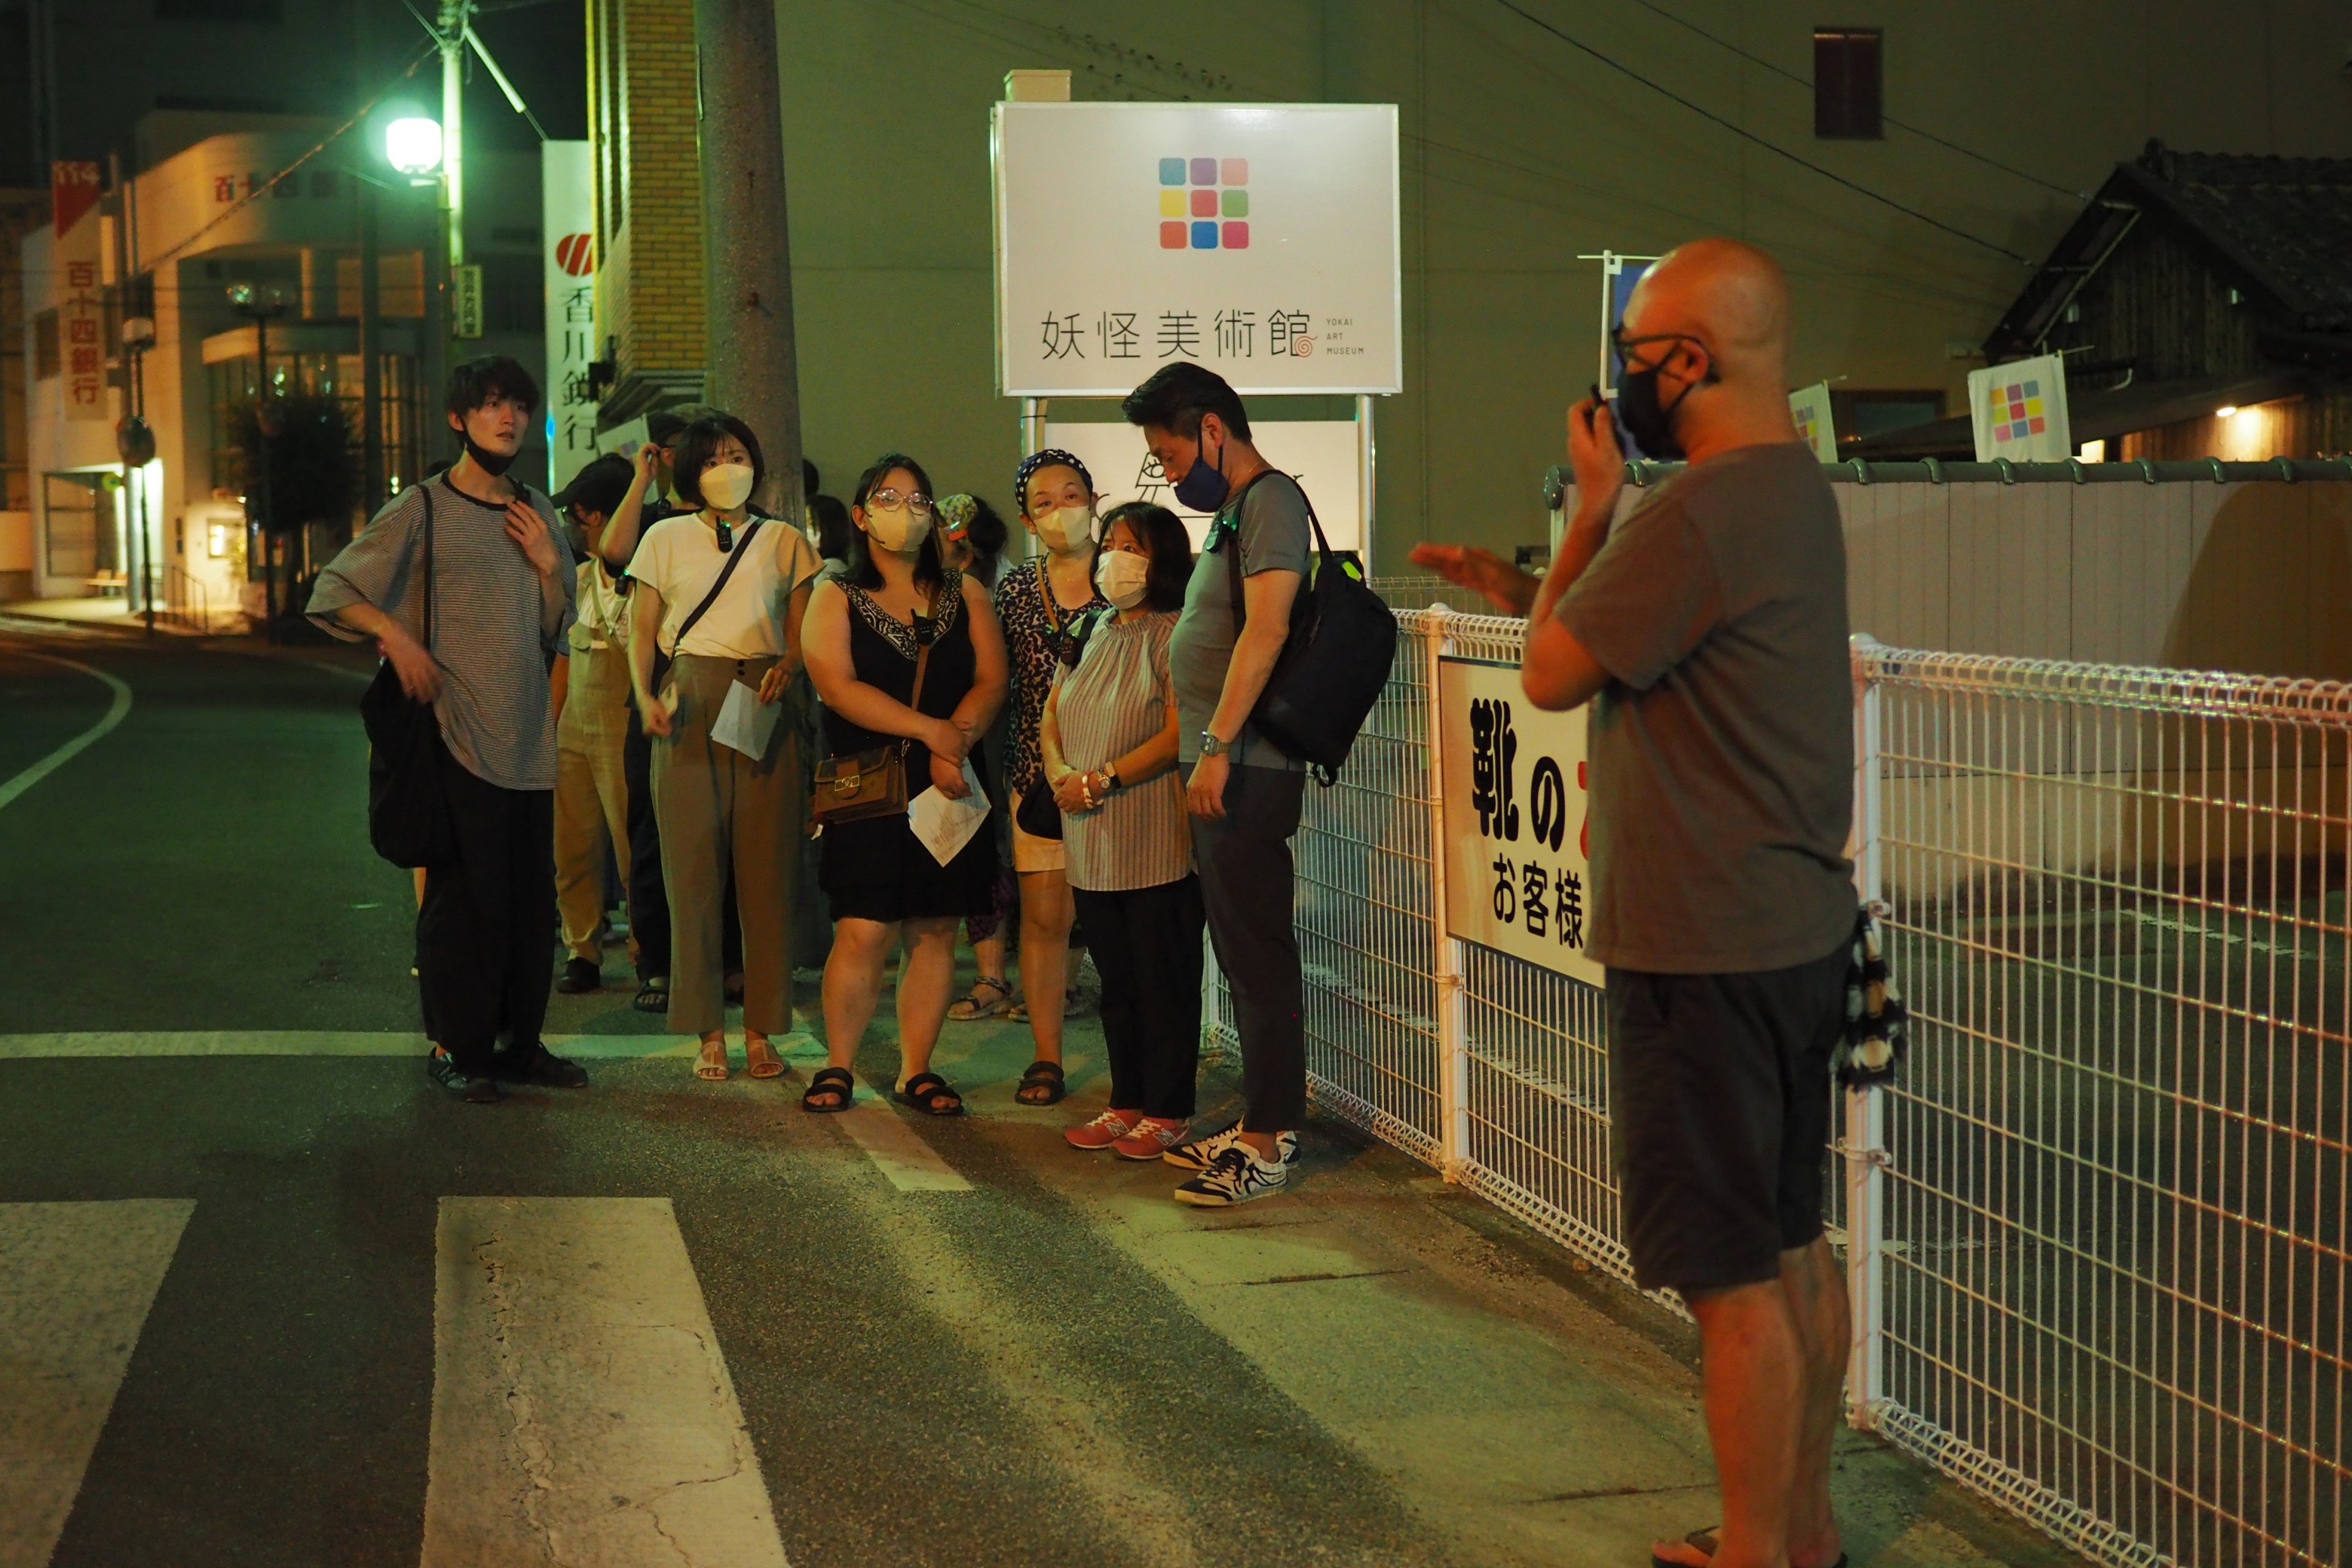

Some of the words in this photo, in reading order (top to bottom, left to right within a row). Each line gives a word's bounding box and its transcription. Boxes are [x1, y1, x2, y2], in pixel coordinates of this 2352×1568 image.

[1041, 309, 1311, 360] 妖怪美術館
[1326, 347, 1365, 355] MUSEUM
[1469, 697, 1589, 861] 靴の
[1492, 852, 1584, 949] お客様
